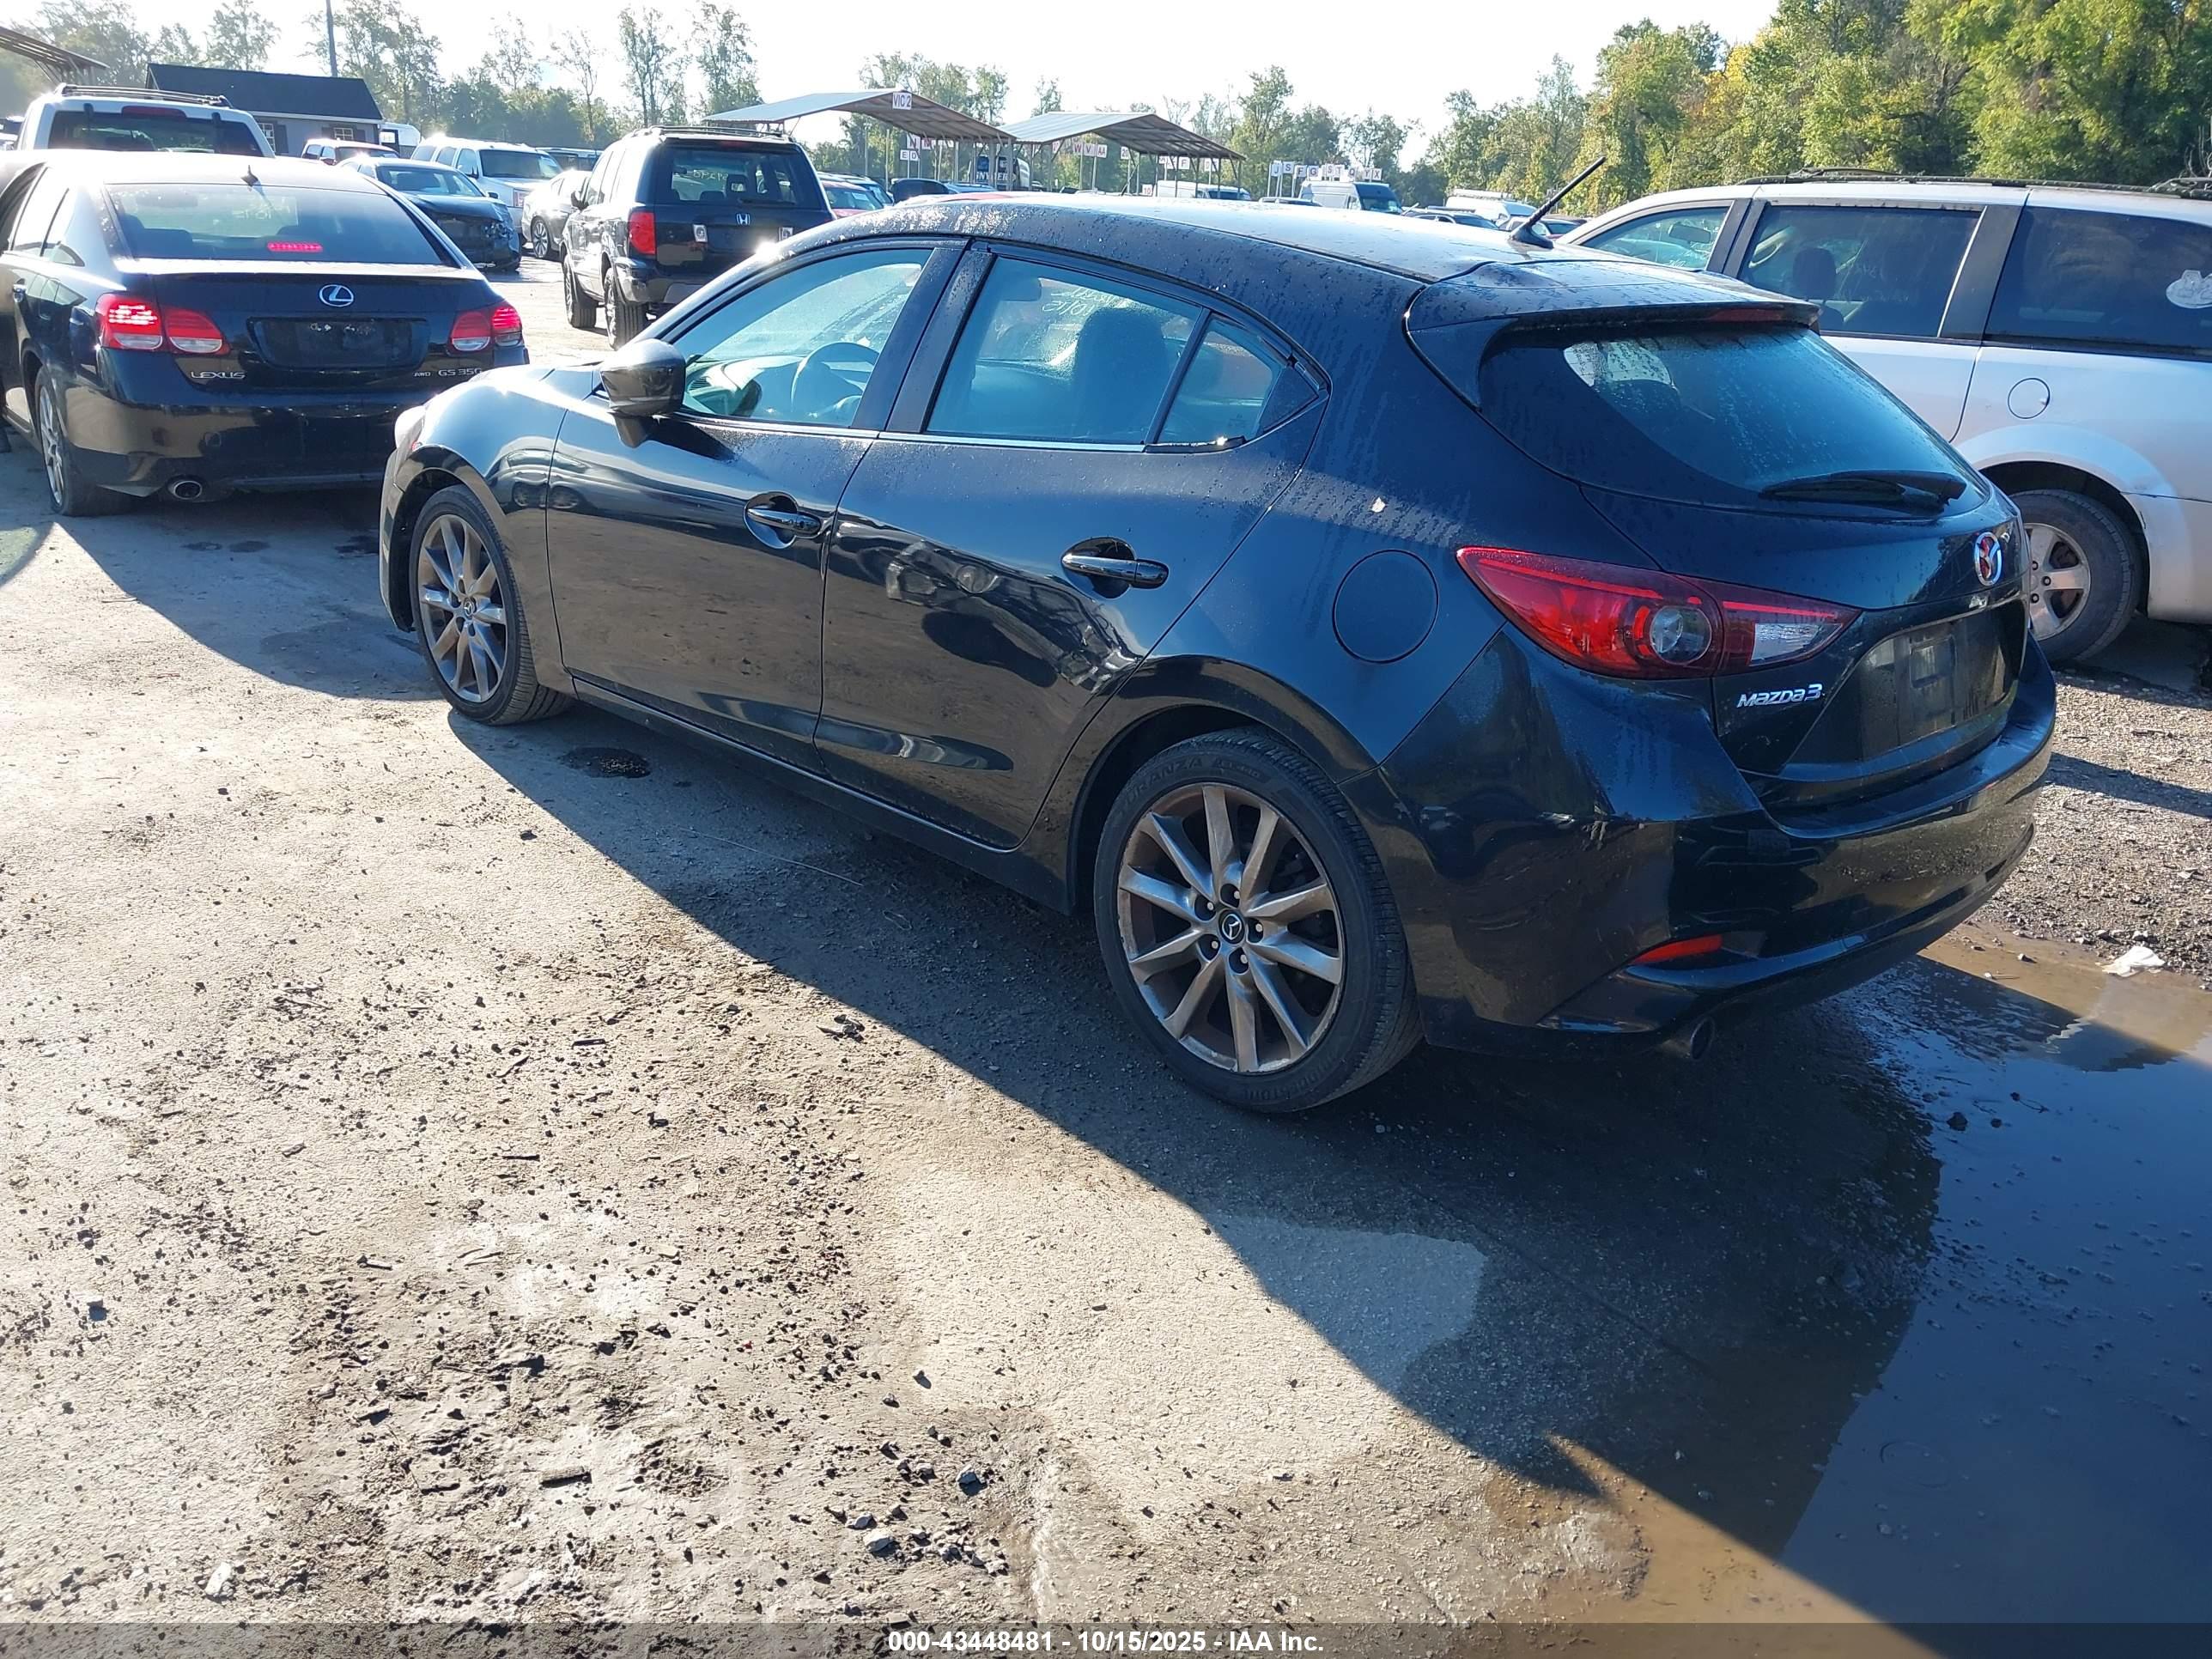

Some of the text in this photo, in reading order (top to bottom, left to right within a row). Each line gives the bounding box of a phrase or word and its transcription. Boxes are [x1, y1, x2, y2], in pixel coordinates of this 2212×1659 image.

[893, 94, 911, 106] VIC 2
[1085, 144, 1091, 153] V
[1181, 159, 1187, 168] F
[1285, 163, 1291, 172] S
[1310, 167, 1317, 176] G
[1373, 170, 1380, 179] X
[1143, 186, 1152, 195] 10
[191, 370, 246, 380] LEXUS
[438, 368, 457, 377] GS
[457, 368, 482, 377] 350
